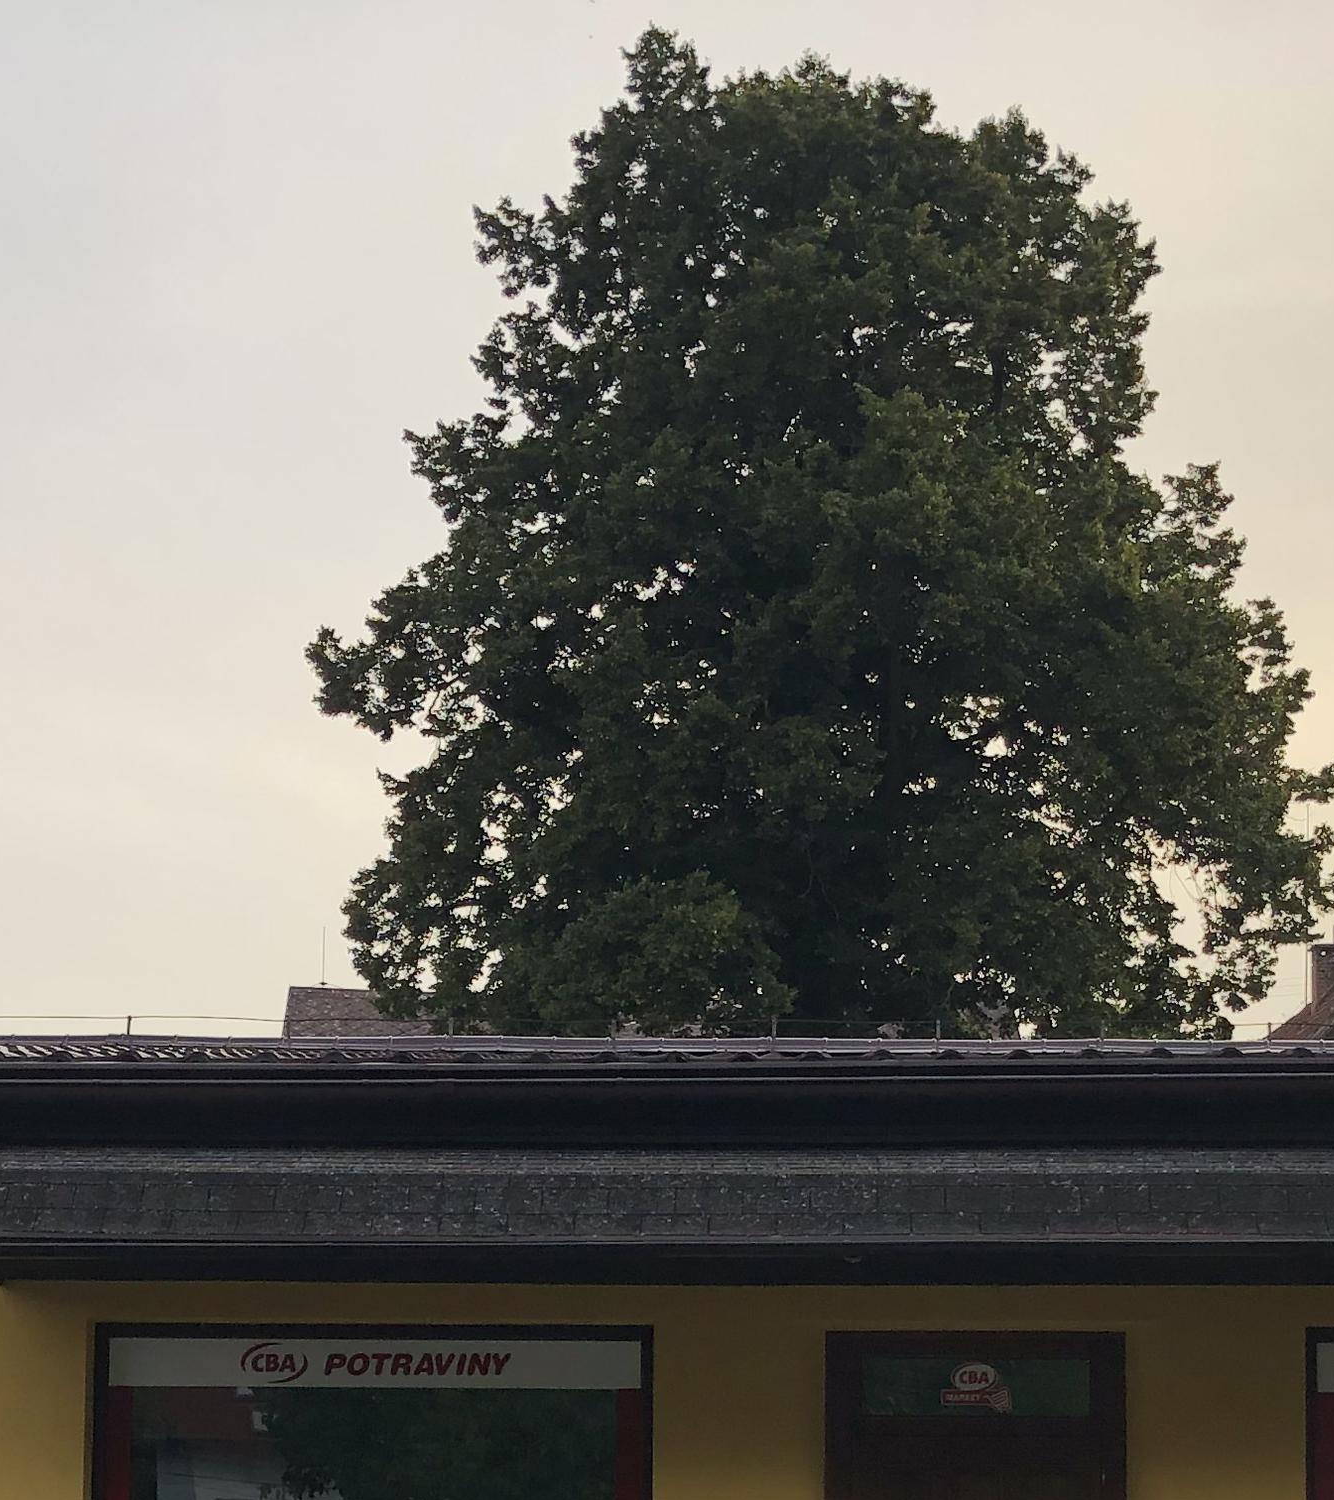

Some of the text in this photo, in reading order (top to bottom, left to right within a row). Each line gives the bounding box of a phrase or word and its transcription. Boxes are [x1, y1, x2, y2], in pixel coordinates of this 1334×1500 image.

[250, 1352, 512, 1376] CBA POTRAVINY
[958, 1370, 989, 1385] CBA
